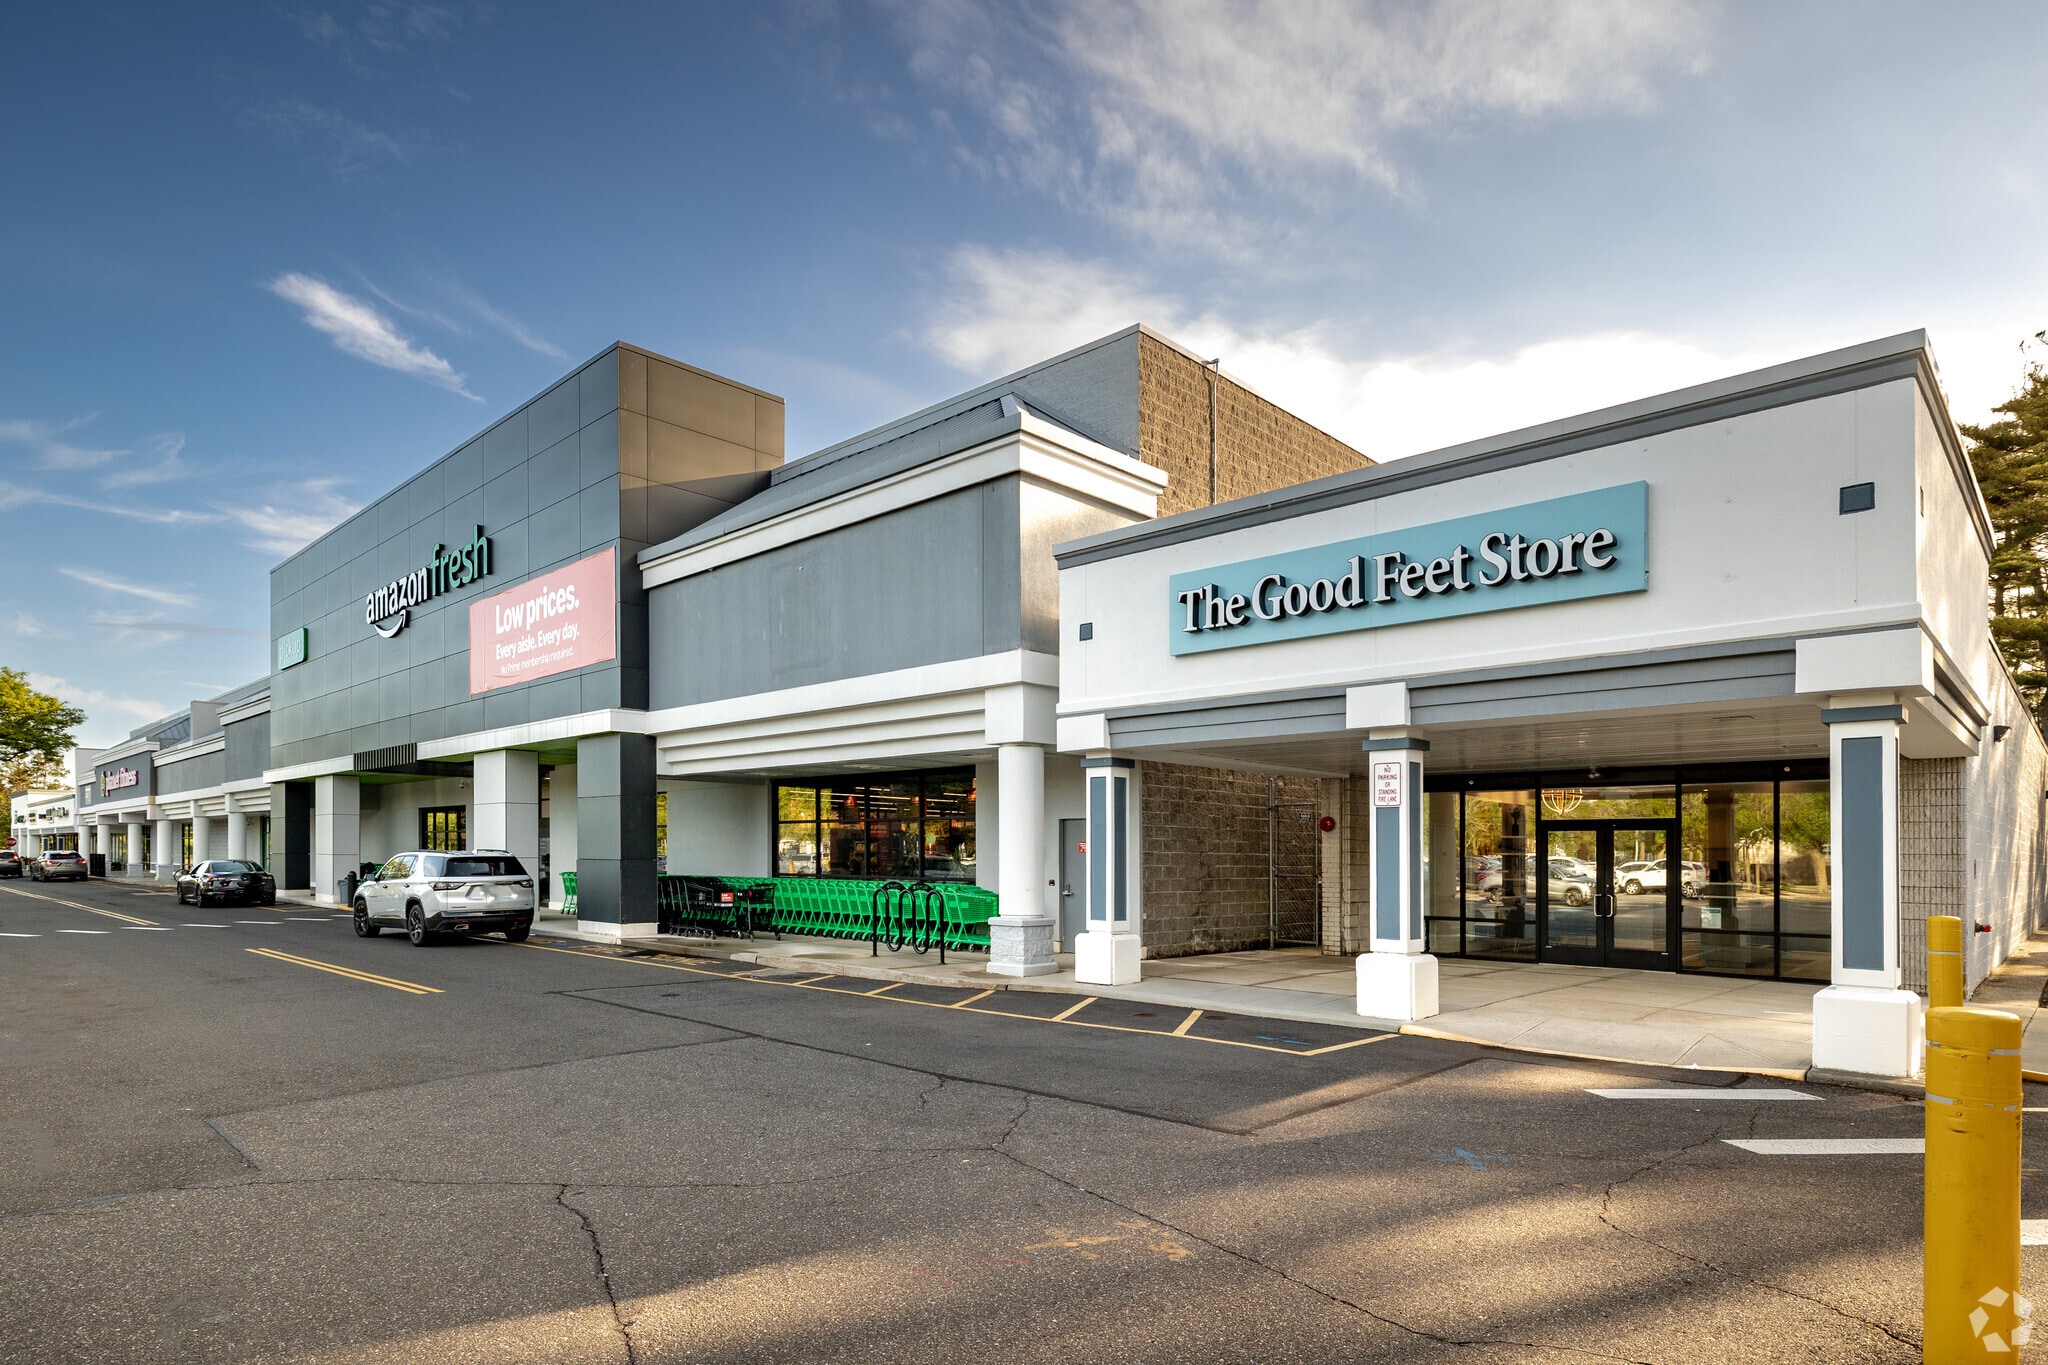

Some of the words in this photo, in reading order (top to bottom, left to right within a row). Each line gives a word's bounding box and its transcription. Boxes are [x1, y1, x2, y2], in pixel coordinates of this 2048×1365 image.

[1177, 583, 1248, 632] The
[1252, 555, 1366, 621] Good
[1372, 544, 1472, 602] Feet
[1479, 527, 1615, 586] Store
[495, 604, 524, 635] Low
[526, 584, 580, 631] prices.
[496, 643, 517, 660] Every
[517, 634, 537, 654] aisle.
[538, 630, 561, 647] Every
[562, 622, 579, 641] day.
[500, 664, 507, 675] No
[507, 660, 521, 673] Prime
[520, 653, 549, 669] membership
[550, 646, 573, 661] required.
